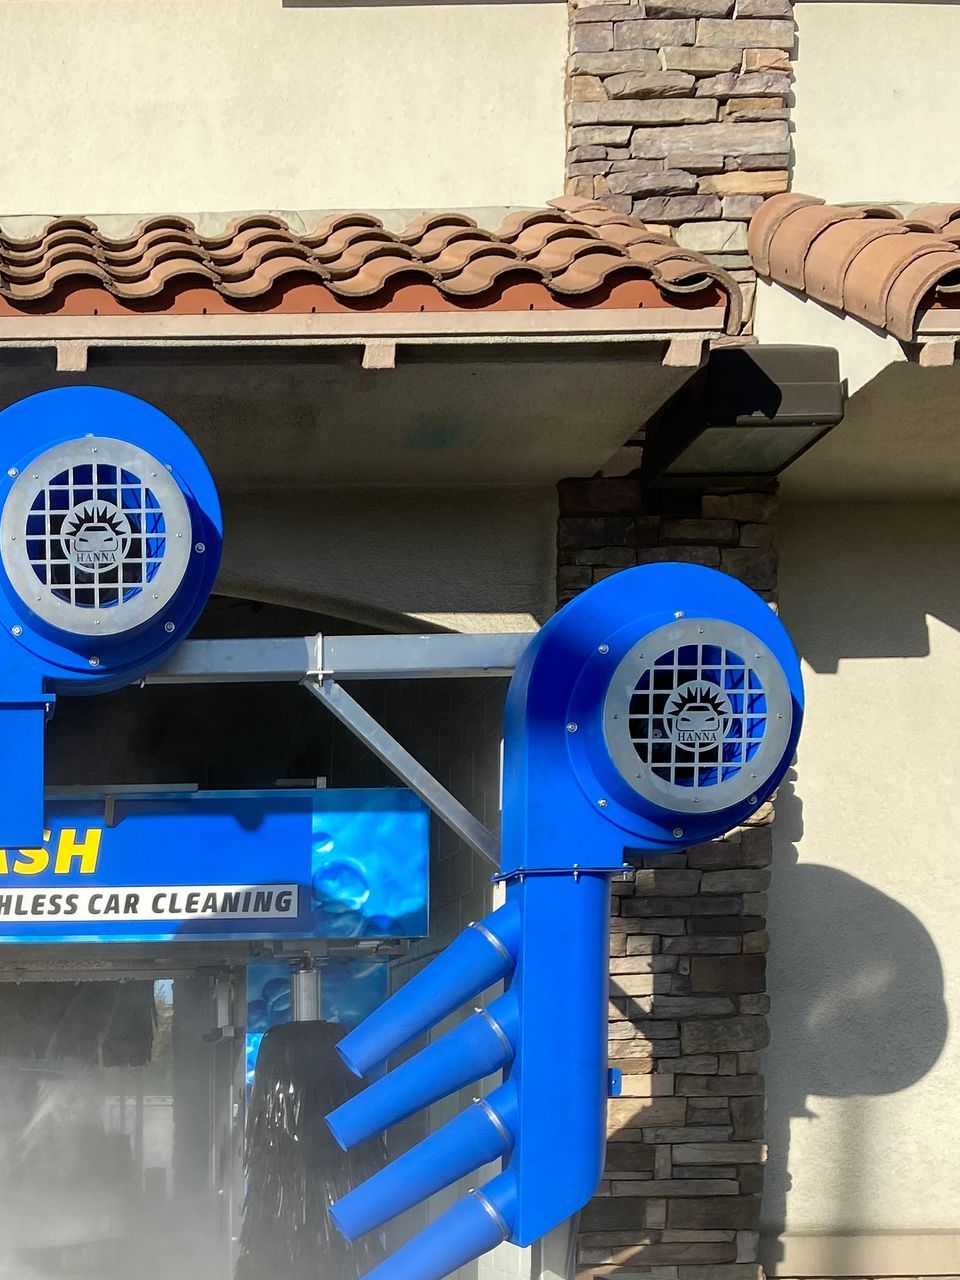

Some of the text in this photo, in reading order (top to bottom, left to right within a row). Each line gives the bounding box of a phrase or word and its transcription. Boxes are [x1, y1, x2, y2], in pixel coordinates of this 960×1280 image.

[76, 553, 116, 562] HANNA
[677, 732, 717, 742] HANNA
[88, 892, 140, 914] CAR
[151, 890, 293, 913] CLEANING
